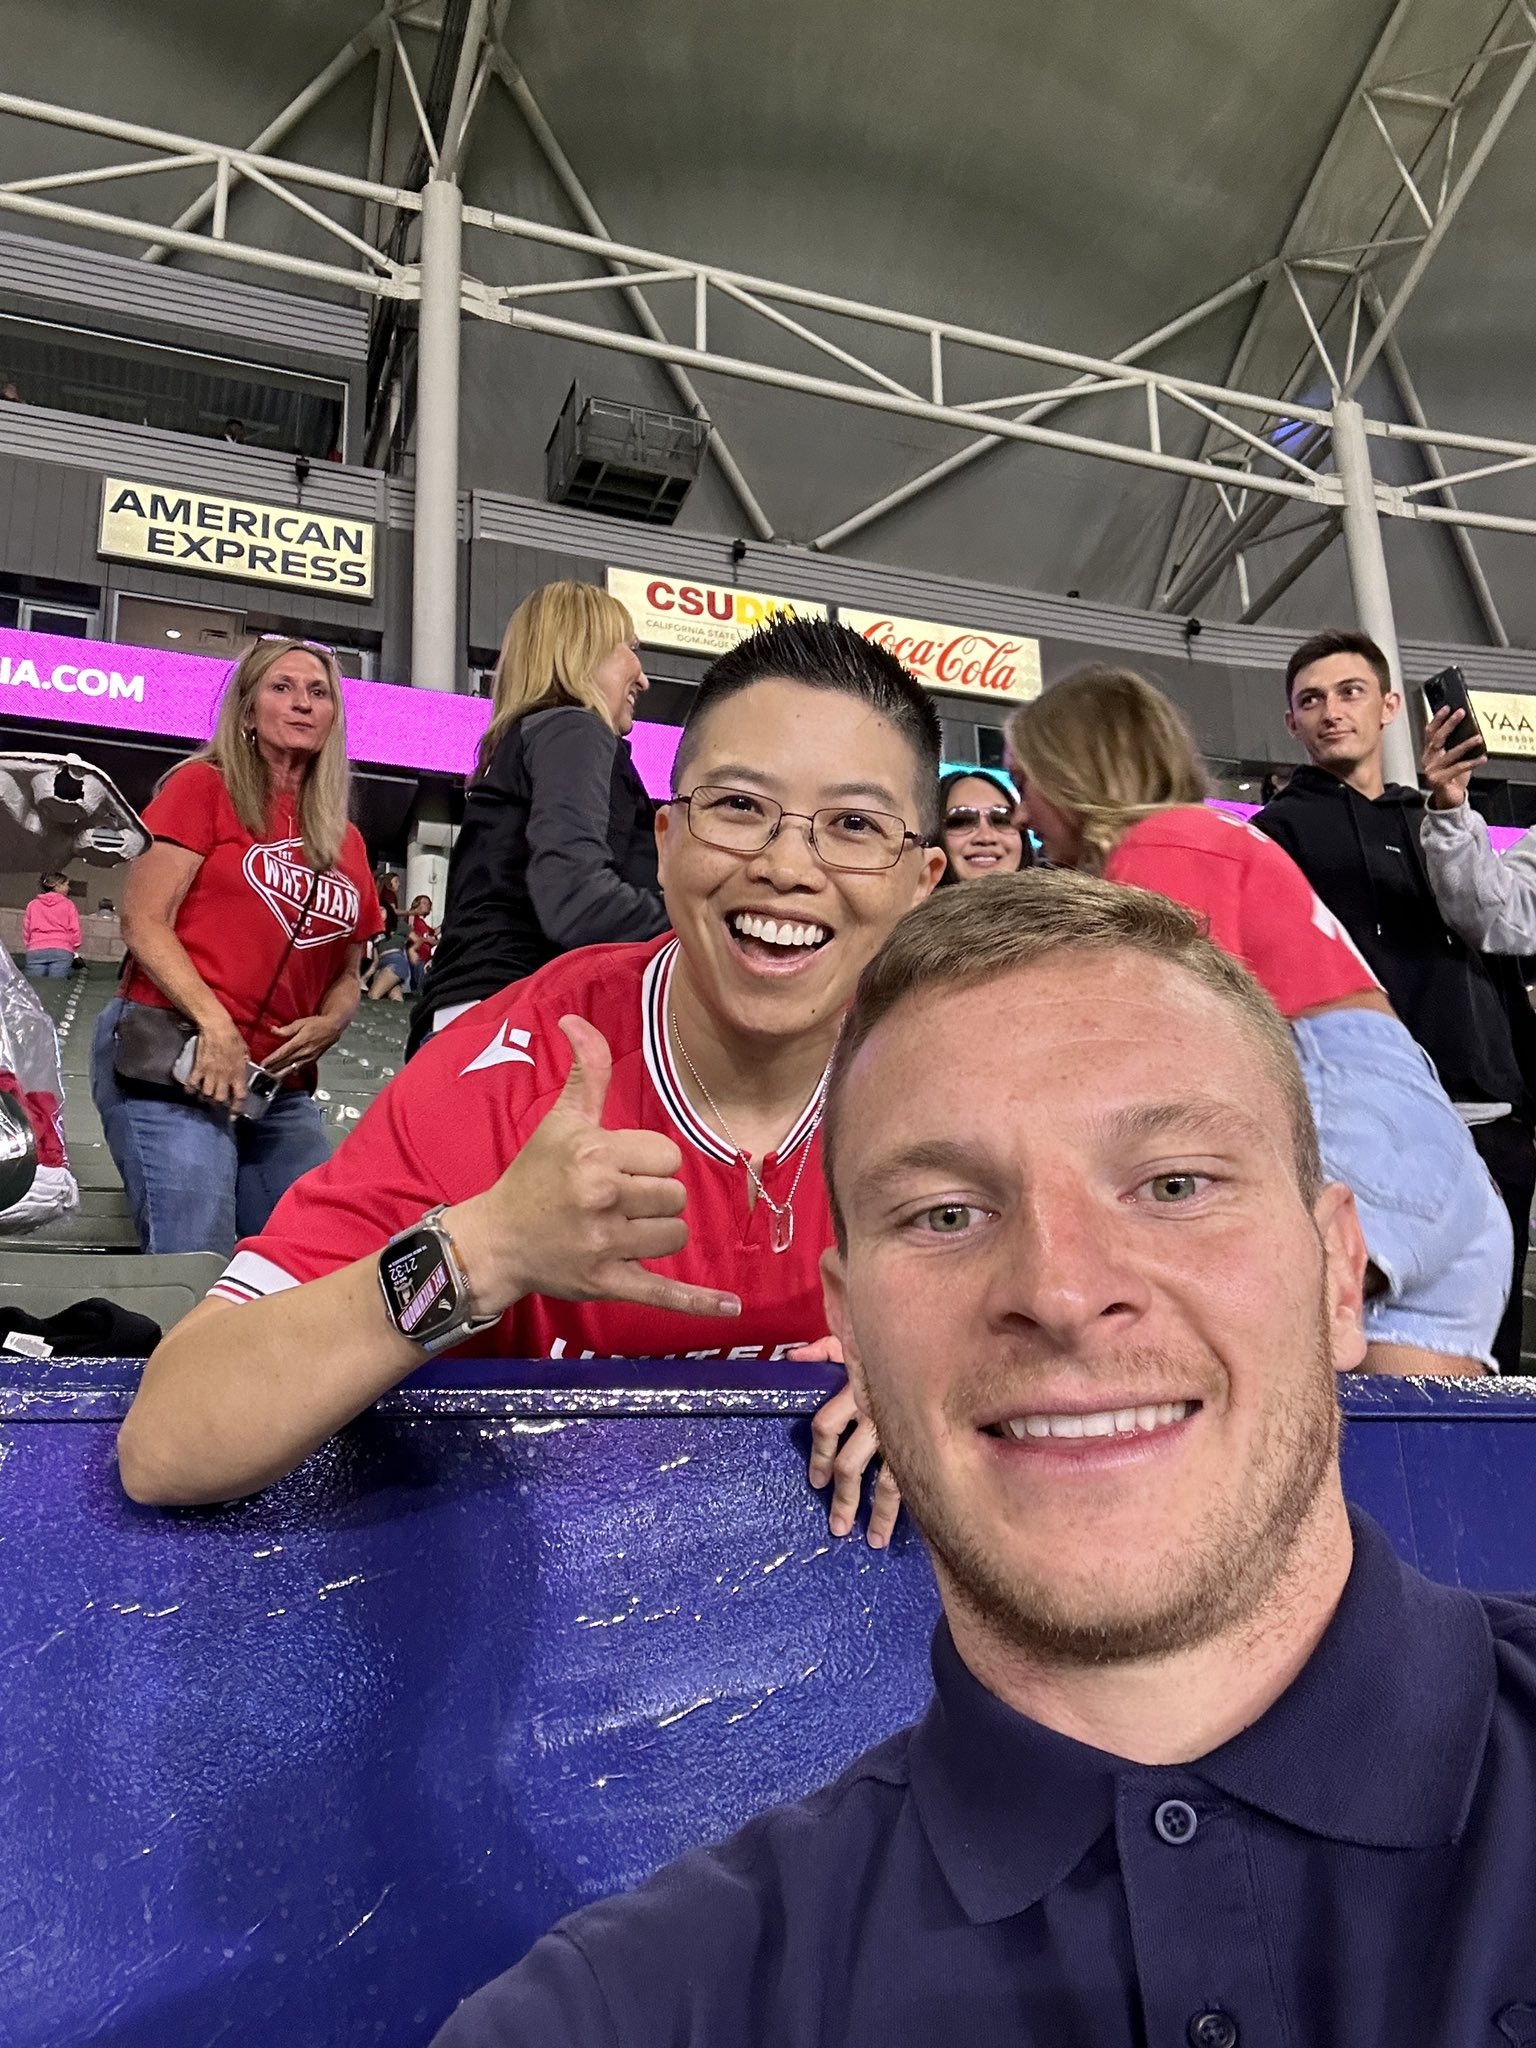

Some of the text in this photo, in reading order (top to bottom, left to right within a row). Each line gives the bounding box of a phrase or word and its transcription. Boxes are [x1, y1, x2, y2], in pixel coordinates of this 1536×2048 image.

[109, 489, 363, 554] AMERICAN
[147, 526, 366, 587] EXPRESS
[645, 619, 736, 641] CALIFORNIA STATE
[676, 633, 732, 649] DOMINGUE
[864, 621, 1024, 691] Coca-Cola
[389, 1257, 418, 1281] 21:32
